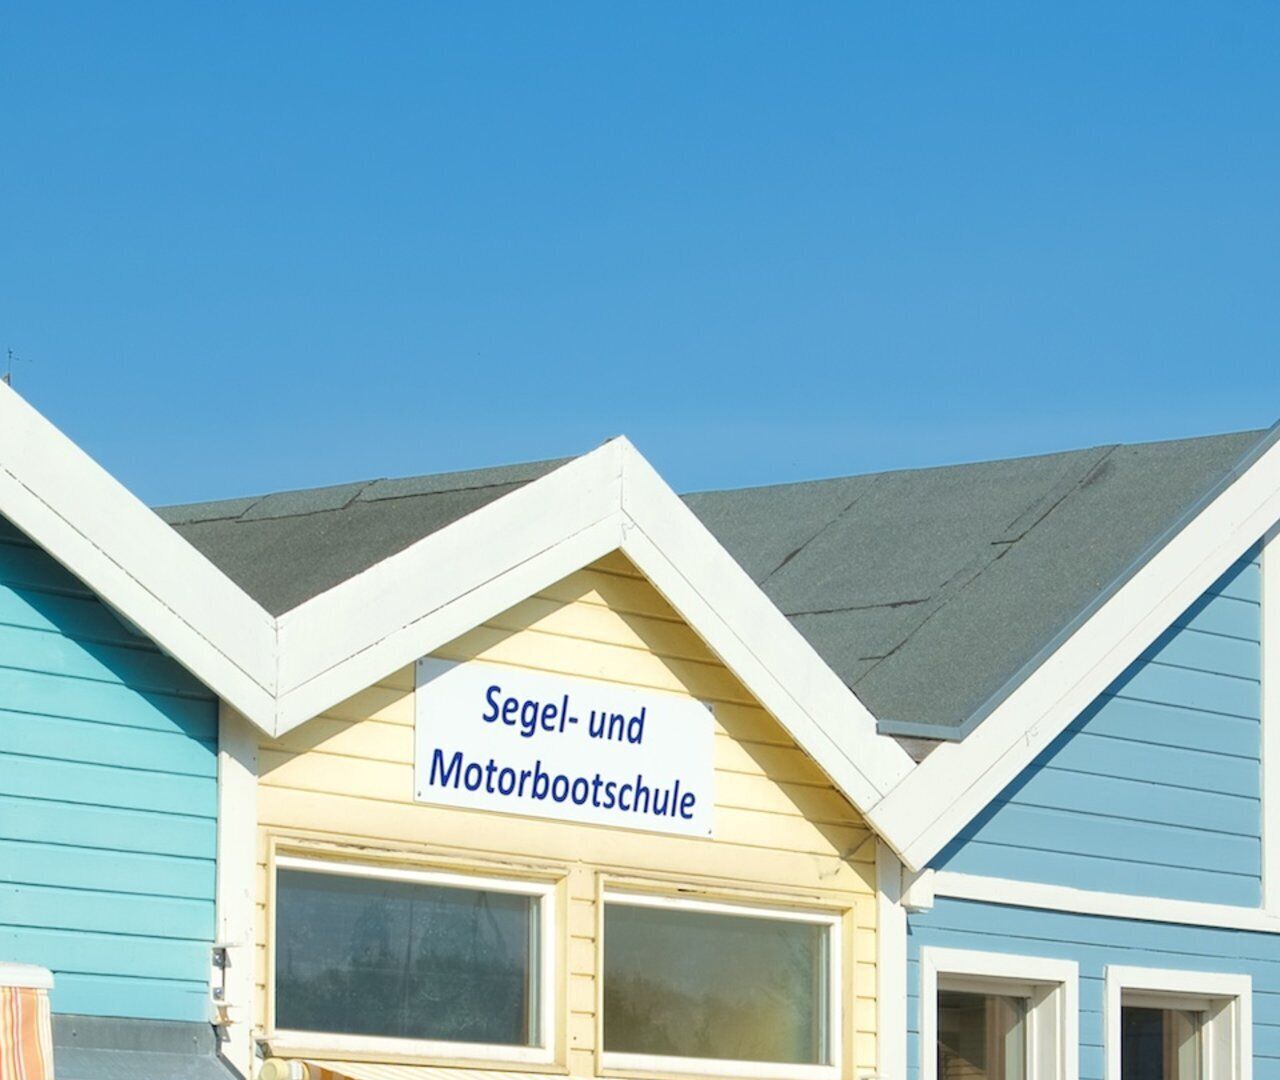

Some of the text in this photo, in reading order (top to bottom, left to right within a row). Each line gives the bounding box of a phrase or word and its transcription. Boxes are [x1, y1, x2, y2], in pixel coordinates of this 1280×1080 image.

[482, 685, 646, 744] Segel- und
[428, 749, 696, 819] Motorbootschule
